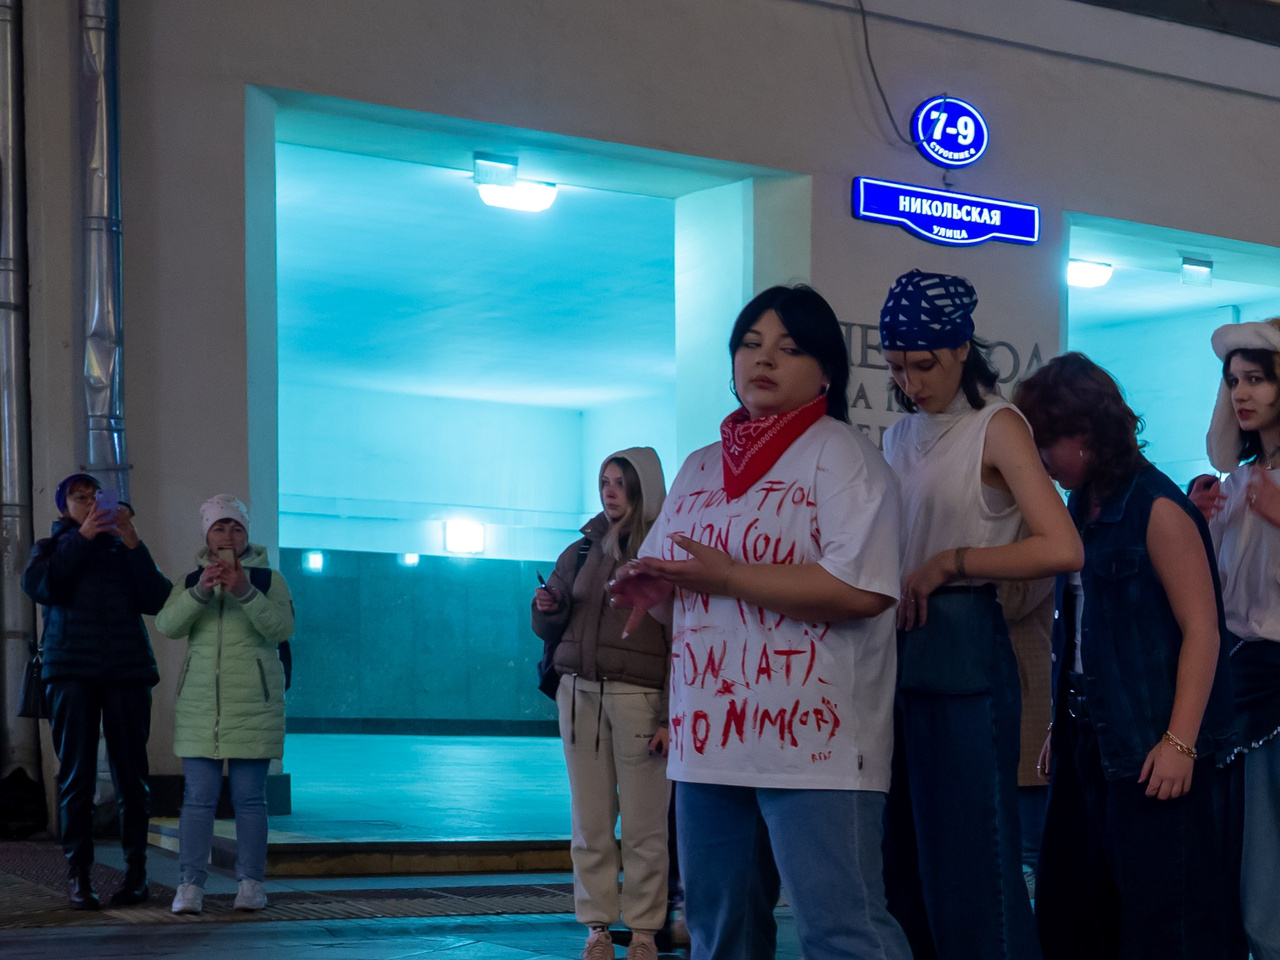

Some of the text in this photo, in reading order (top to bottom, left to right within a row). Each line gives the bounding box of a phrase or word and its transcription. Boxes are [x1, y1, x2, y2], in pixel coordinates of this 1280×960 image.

[930, 110, 976, 146] 7-9
[929, 141, 971, 160] СТРОЕНИЕ
[898, 195, 1002, 226] НИКОЛЬСКАЯ
[932, 225, 969, 240] УЛИЦА
